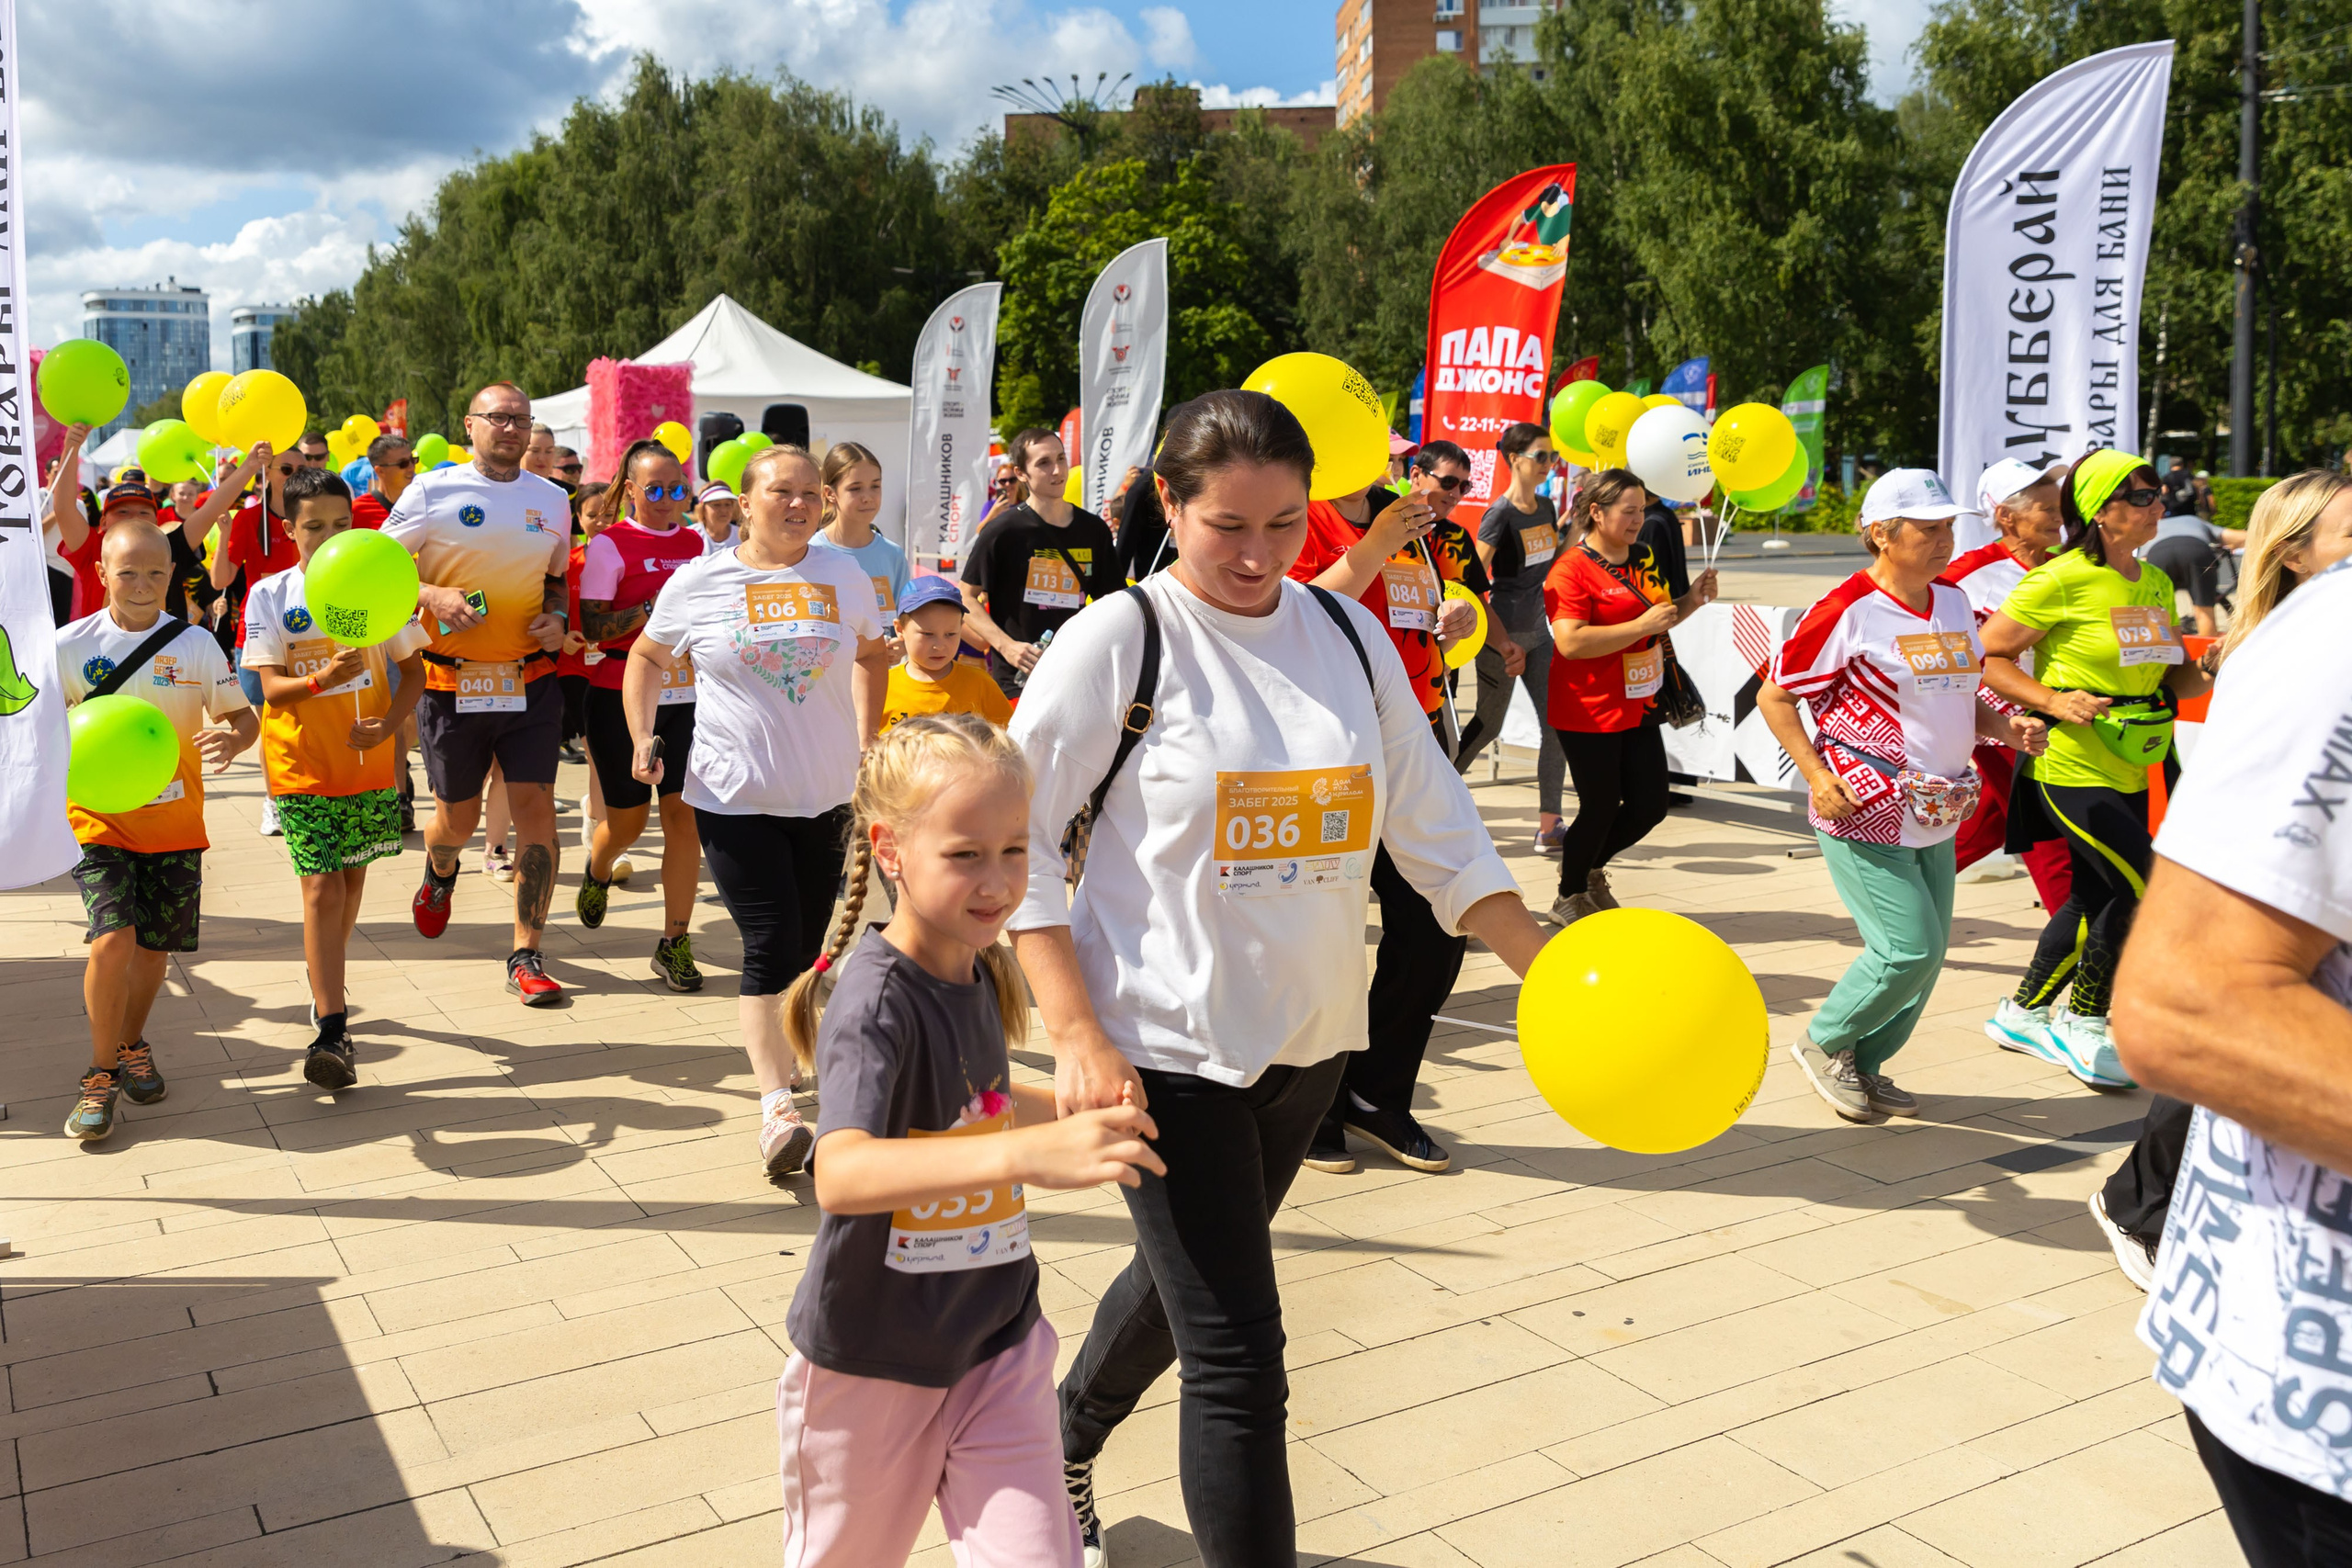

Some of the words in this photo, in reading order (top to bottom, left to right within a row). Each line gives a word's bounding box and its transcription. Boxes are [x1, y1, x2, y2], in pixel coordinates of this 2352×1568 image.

[2096, 164, 2132, 263] БАНИ
[2093, 276, 2129, 345] ДЛЯ
[1440, 326, 1544, 371] ПАПА
[1435, 367, 1544, 399] ДЖОНС
[2086, 359, 2120, 454] ВАРЫ
[1096, 426, 1114, 518] ШНИКОВ
[938, 434, 953, 543] КАЛАШНИКОВ
[949, 494, 962, 543] СПОРТ
[1593, 555, 1627, 582] LOVE
[1033, 573, 1057, 588] 113
[1389, 582, 1420, 604] 084
[754, 601, 797, 618] 106
[2118, 626, 2152, 643] 079
[1911, 651, 1948, 671] 096
[153, 675, 170, 687] 2025
[1628, 664, 1654, 682] 093
[460, 678, 493, 694] 040
[1229, 785, 1299, 794] БЛАГОТВОРИТЕЛЬНЫЙ
[1228, 797, 1269, 808] ЗАБЕГ
[1272, 795, 1298, 807] 2025
[1227, 813, 1301, 850] 036
[914, 1235, 963, 1244] КАЛАШНИКОВ
